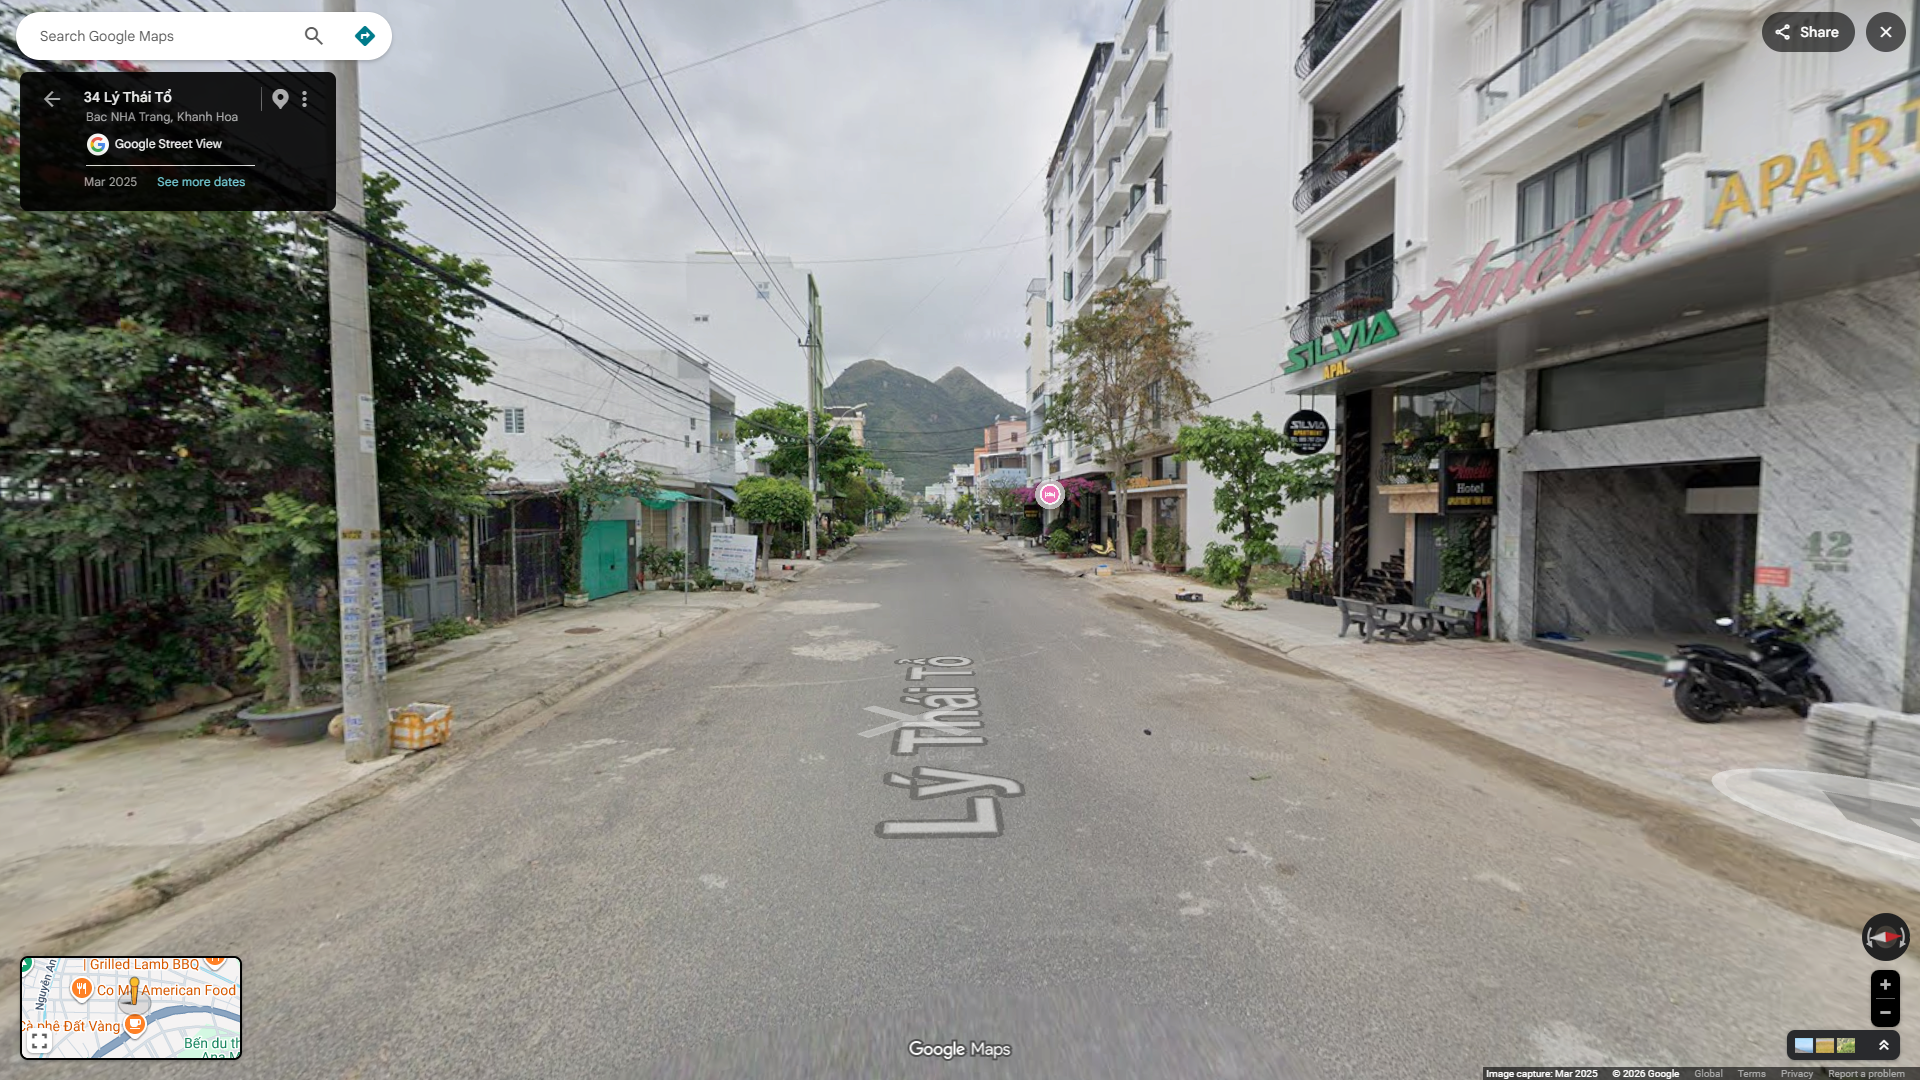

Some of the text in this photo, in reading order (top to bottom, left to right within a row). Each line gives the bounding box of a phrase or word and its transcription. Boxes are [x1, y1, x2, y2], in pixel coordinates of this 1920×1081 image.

[1408, 197, 1683, 328] Amélie
[1284, 310, 1400, 375] SILVIA
[1290, 420, 1326, 430] SILVIA
[1456, 482, 1484, 494] Hotel
[1801, 530, 1853, 558] 42
